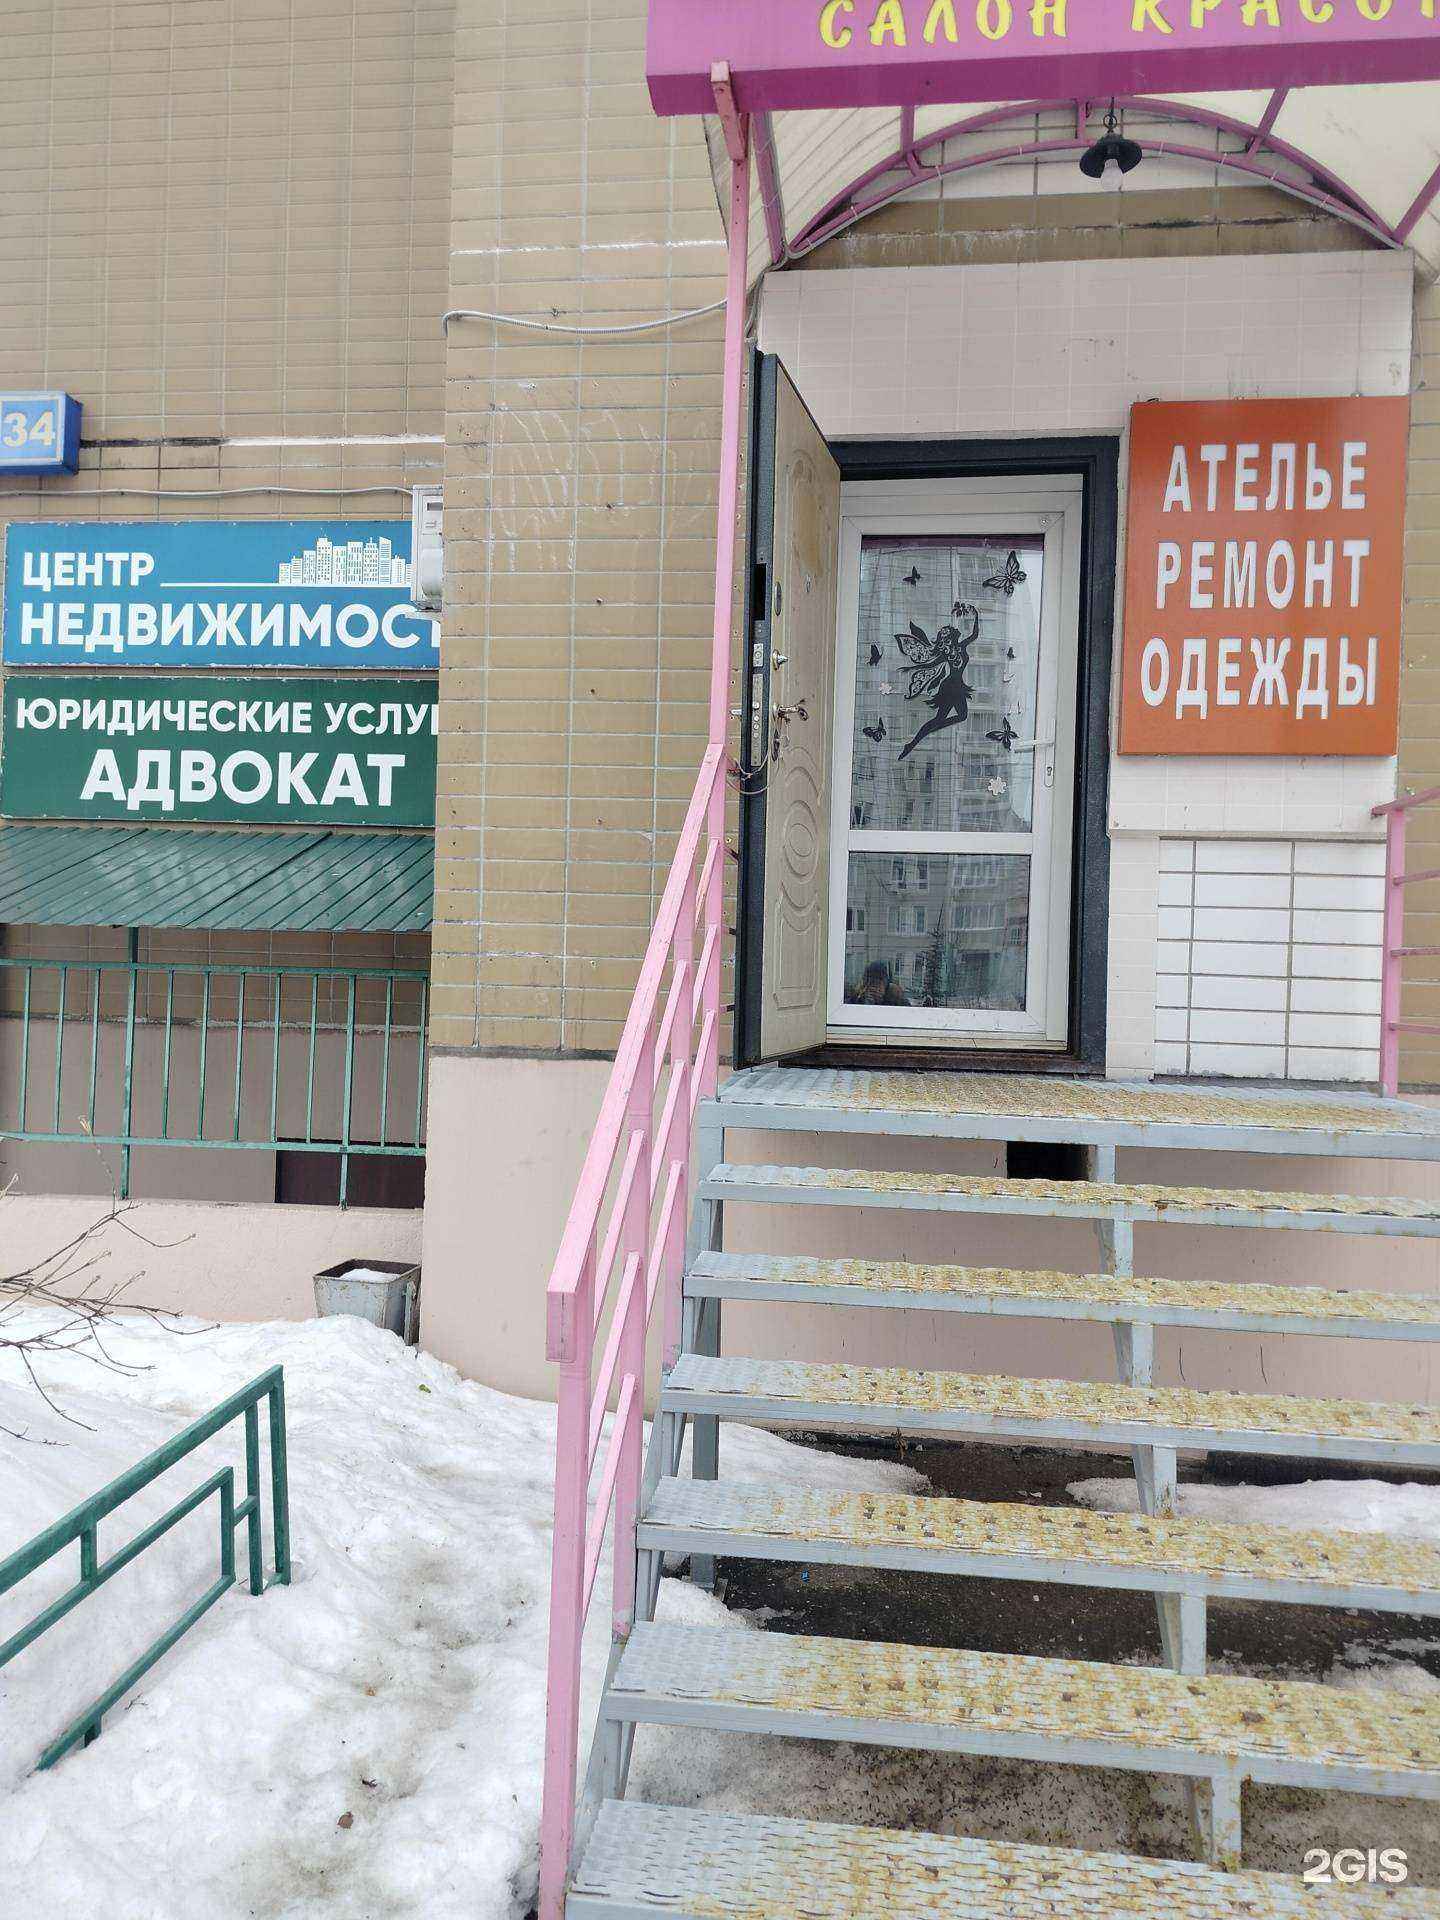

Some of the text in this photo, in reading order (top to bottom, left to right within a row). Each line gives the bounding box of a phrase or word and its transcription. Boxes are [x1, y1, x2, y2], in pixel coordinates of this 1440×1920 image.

[819, 0, 1067, 48] САЛОН
[3, 411, 56, 448] 34
[1162, 442, 1367, 512] АТЕЛЬЕ
[22, 551, 155, 591] ЦЕНТР
[1156, 540, 1370, 609] РЕМОНТ
[1140, 637, 1377, 720] ОДЕЖДЫ
[16, 697, 312, 736] ЮРИДИЧЕСКИЕ
[80, 748, 406, 811] АДВОКАТ
